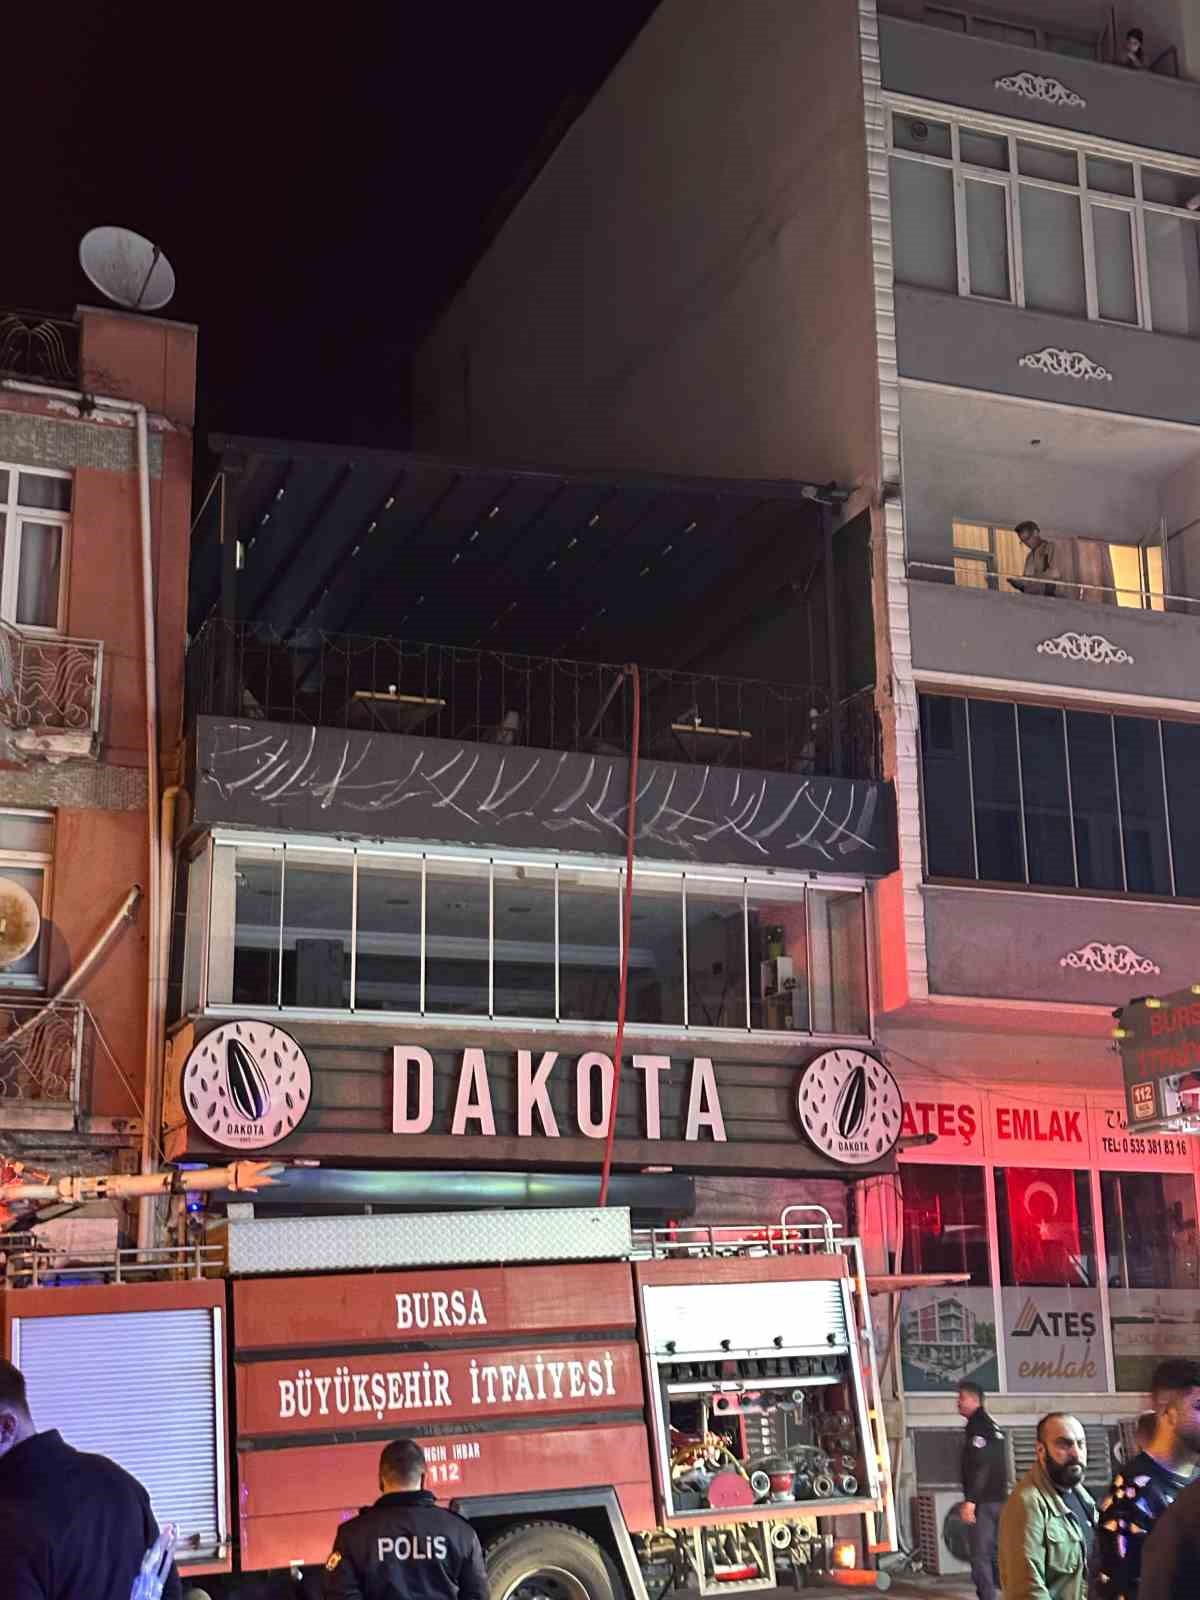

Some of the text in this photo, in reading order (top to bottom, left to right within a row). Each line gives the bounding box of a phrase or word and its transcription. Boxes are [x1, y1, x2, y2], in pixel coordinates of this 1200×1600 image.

[392, 1045, 728, 1141] DAKOTA
[1134, 1086, 1152, 1101] 112
[227, 1123, 264, 1136] DAKOTA
[902, 1102, 977, 1146] ATEŞ
[996, 1108, 1083, 1142] EMLAK
[838, 1141, 870, 1152] DAKOTA
[1102, 1137, 1121, 1152] TEL:
[1123, 1138, 1128, 1152] 0
[1130, 1138, 1145, 1154] 535
[1176, 1140, 1187, 1155] 16
[395, 1290, 487, 1329] BURSA
[1011, 1299, 1097, 1343] ATEŞ
[1018, 1344, 1097, 1378] emlak
[279, 1352, 616, 1420] BÜYÜKŞEHİR İTFAİYESİ
[431, 1462, 460, 1482] 112
